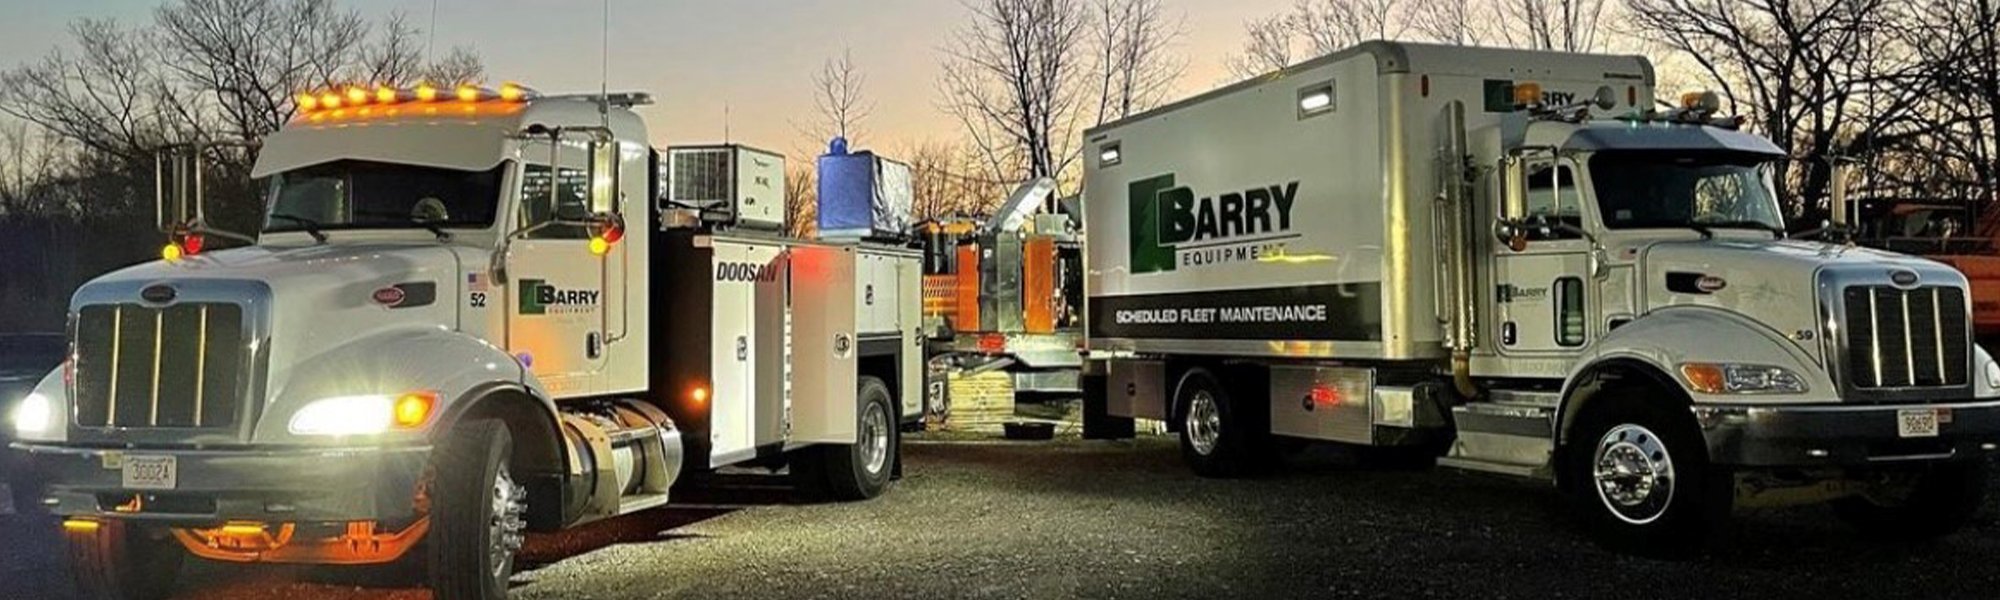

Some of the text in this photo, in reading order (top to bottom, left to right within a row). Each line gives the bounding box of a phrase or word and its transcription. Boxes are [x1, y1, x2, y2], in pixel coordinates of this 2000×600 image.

[1159, 181, 1299, 244] BARRY
[717, 261, 777, 282] DOOSAN
[470, 293, 485, 307] 52
[536, 284, 599, 304] BARRY
[1115, 304, 1326, 324] SCHEDULED FLEET MAINTENANCE
[1796, 329, 1813, 340] 59
